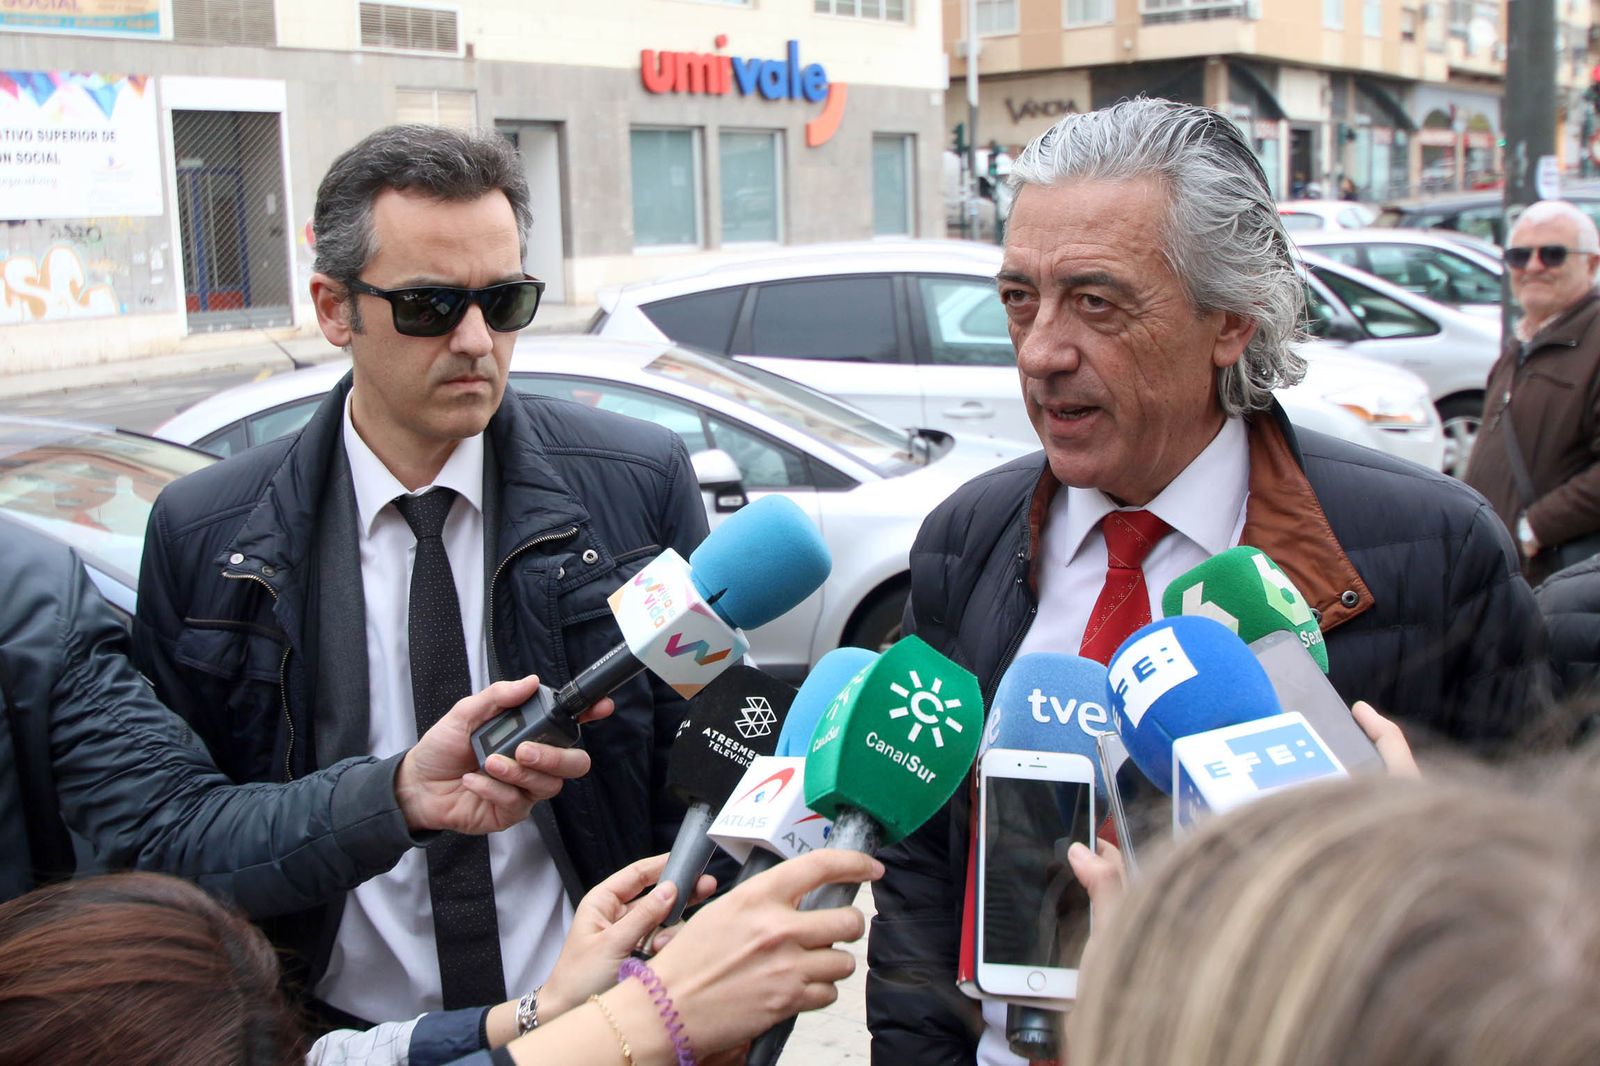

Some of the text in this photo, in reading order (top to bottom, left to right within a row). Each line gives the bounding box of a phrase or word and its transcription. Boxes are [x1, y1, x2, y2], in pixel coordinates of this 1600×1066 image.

[640, 34, 829, 104] umivale
[37, 130, 98, 143] SUPERIOR
[102, 131, 117, 143] DE
[16, 151, 62, 165] SOCIAL
[1027, 688, 1117, 738] tve
[702, 727, 760, 761] ATRESME
[865, 731, 937, 784] CanalSur
[719, 814, 769, 829] ATLAS
